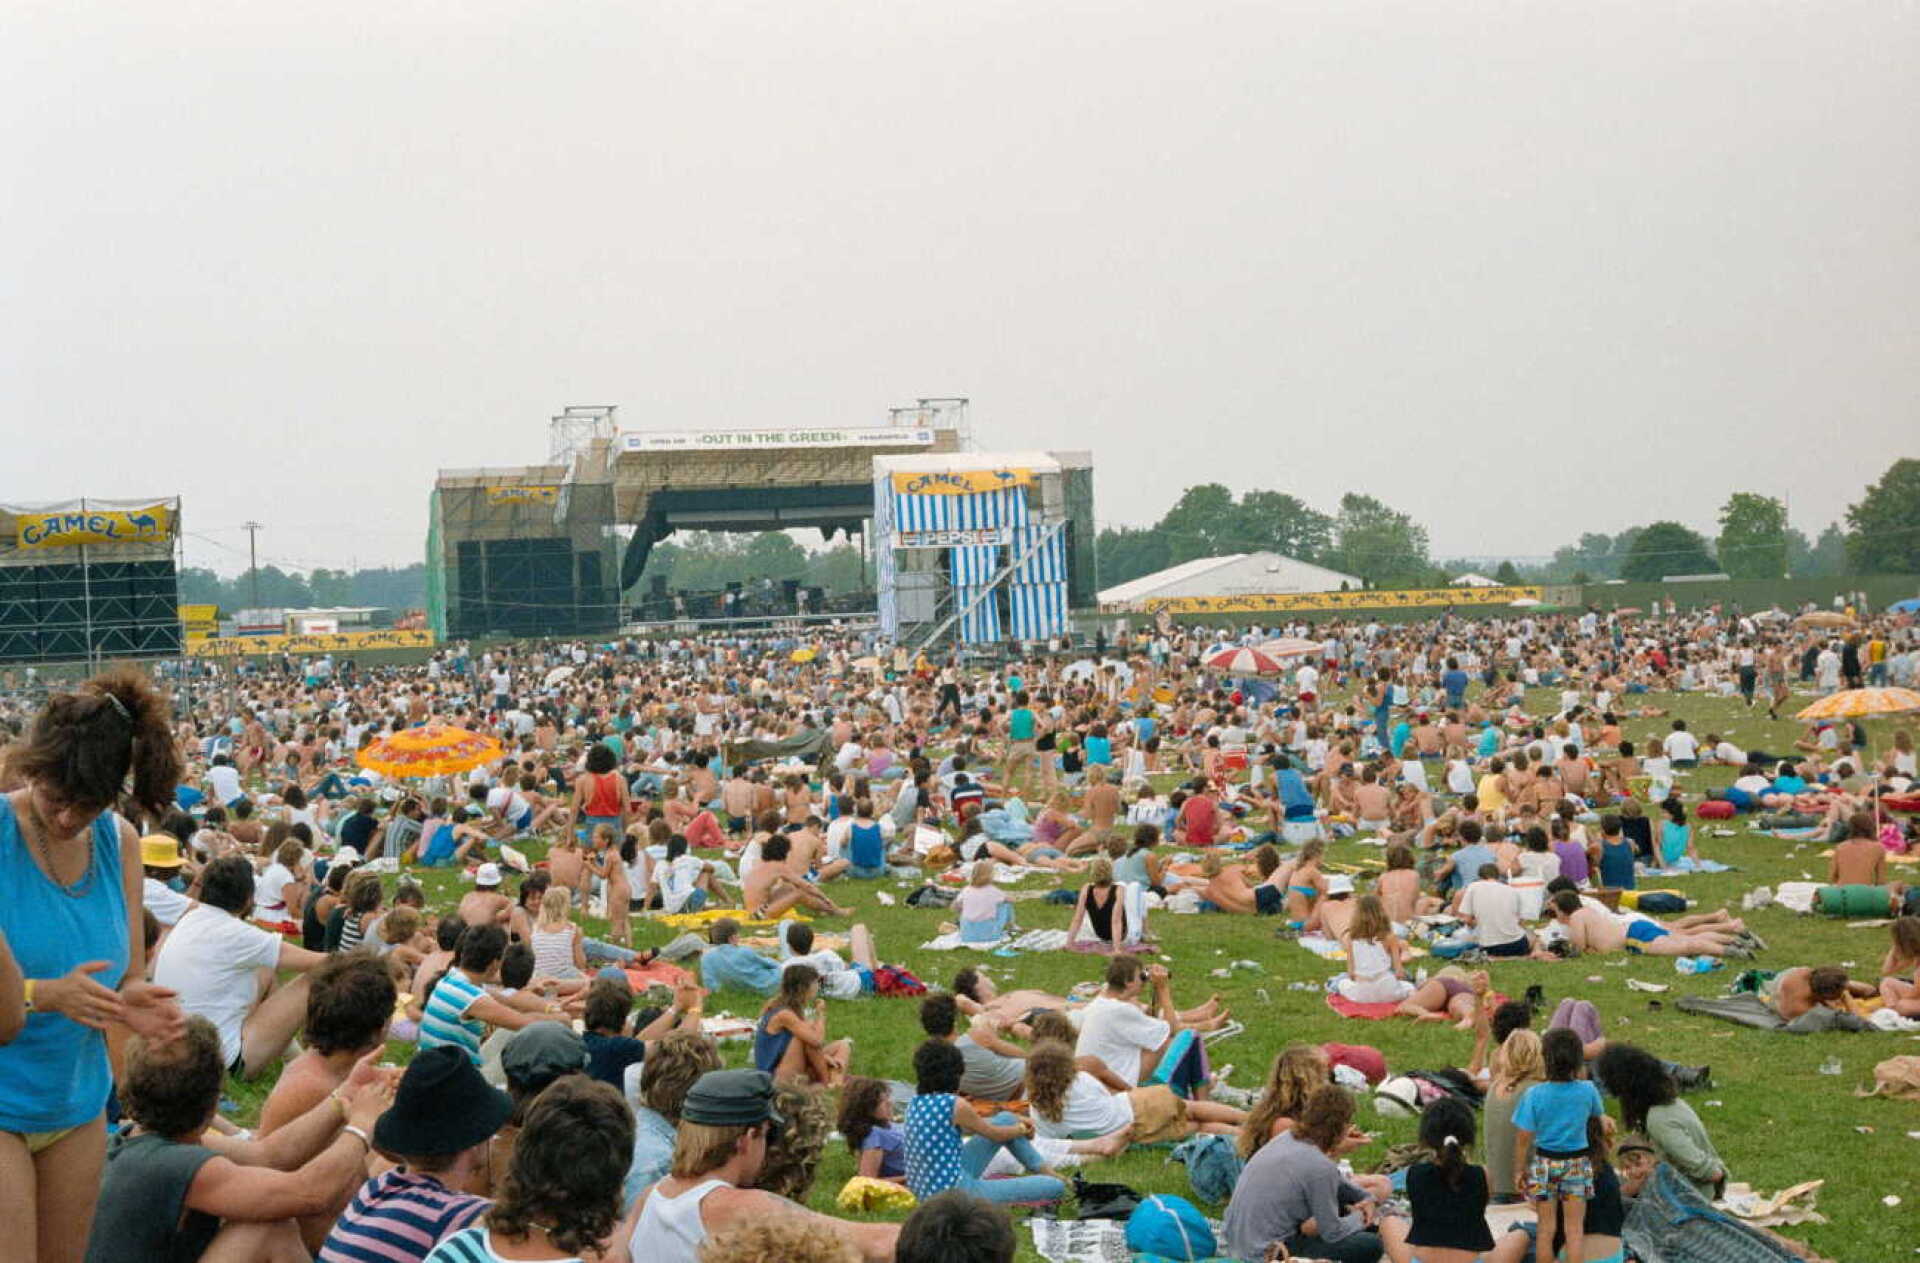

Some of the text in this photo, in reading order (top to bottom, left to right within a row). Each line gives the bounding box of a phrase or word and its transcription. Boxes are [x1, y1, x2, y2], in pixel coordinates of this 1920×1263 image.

[737, 434, 753, 443] IN
[756, 433, 785, 443] THE
[906, 472, 974, 492] CAMEL
[22, 514, 124, 545] CAMEL
[925, 531, 978, 545] PEPSI
[278, 636, 325, 651] CAMEL
[357, 632, 405, 648] CAMEL
